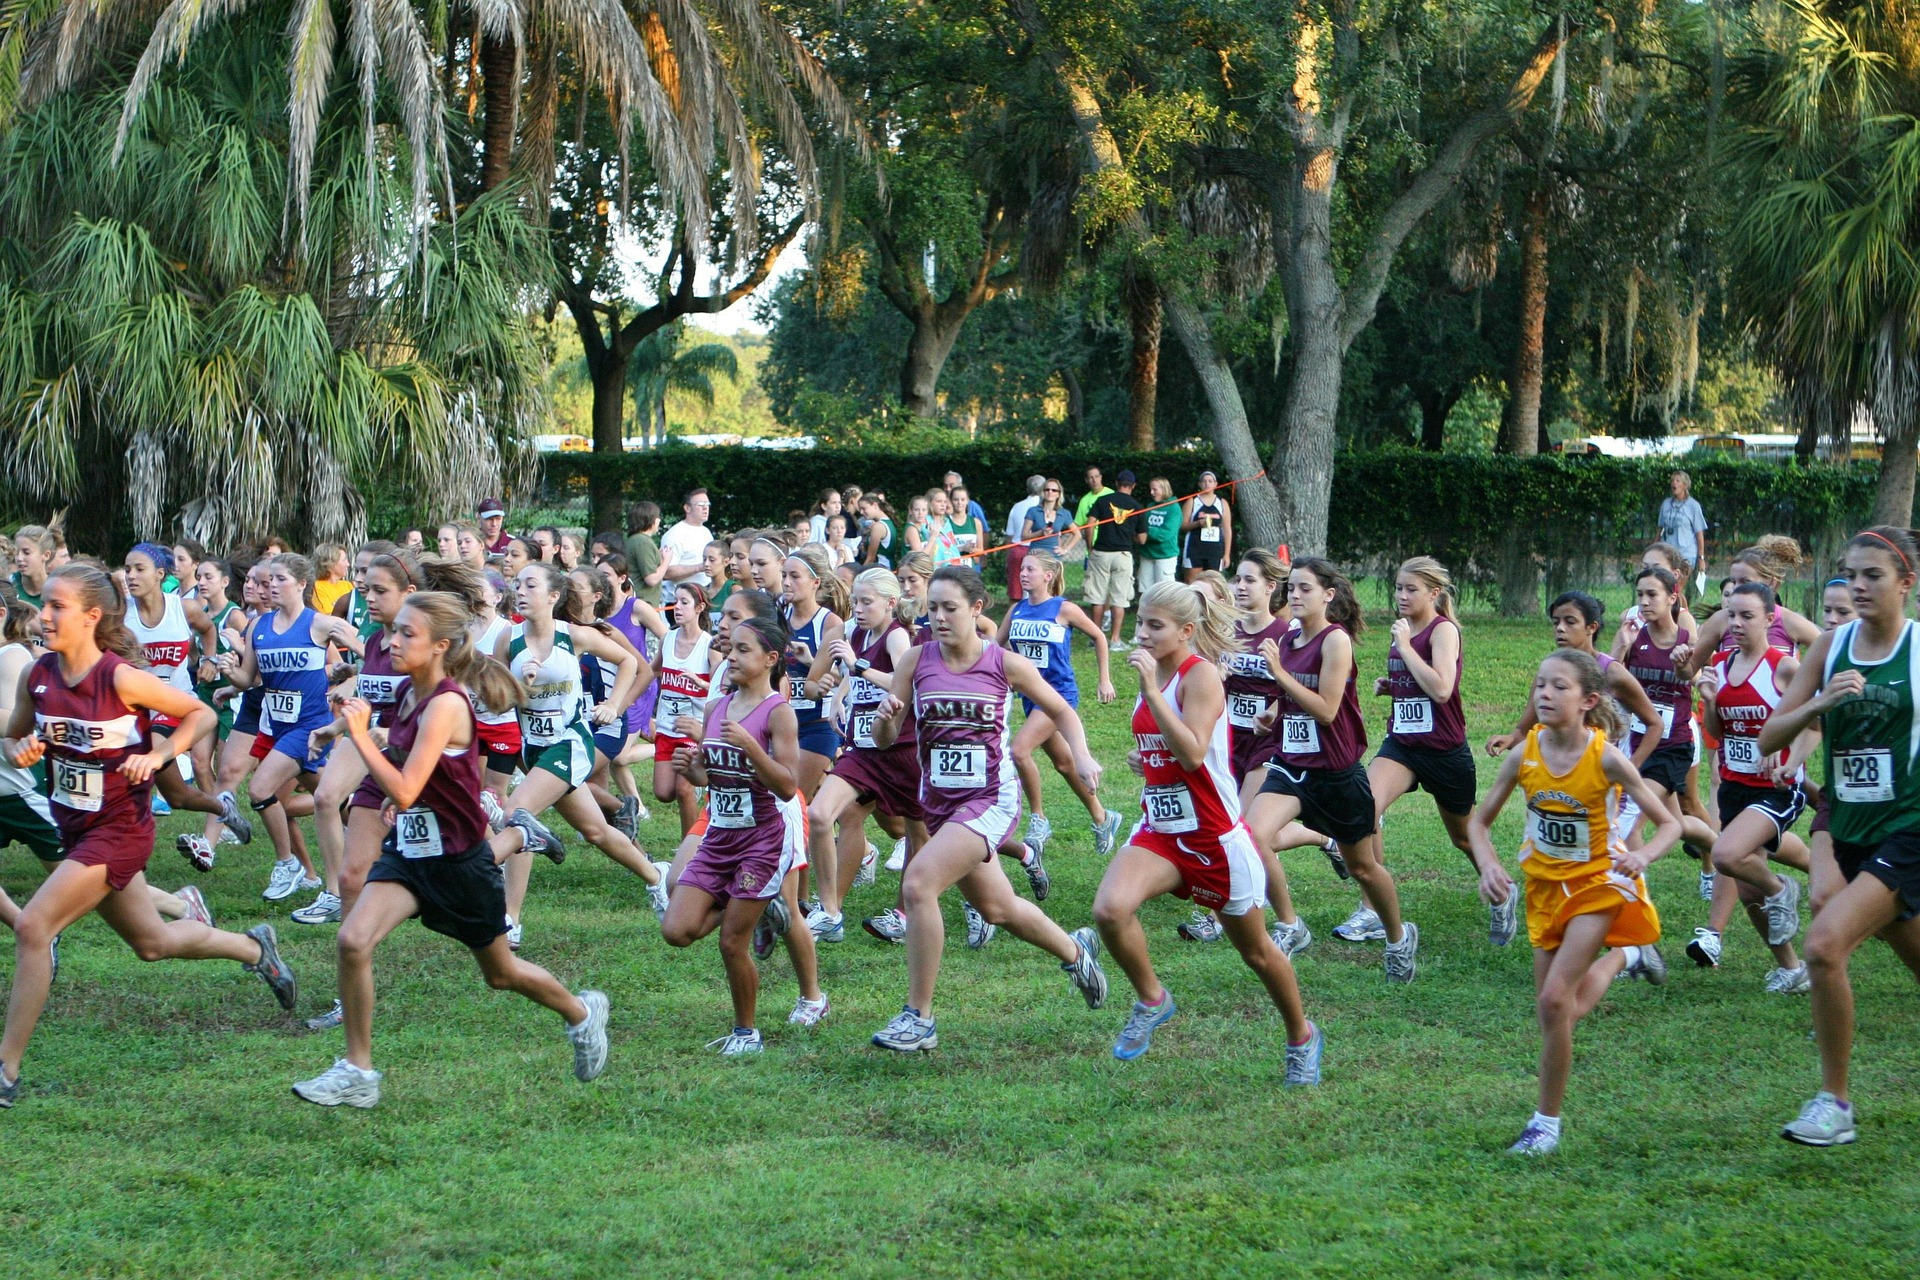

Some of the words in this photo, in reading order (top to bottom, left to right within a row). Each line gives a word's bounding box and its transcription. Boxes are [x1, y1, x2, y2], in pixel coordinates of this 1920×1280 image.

[271, 695, 294, 711] 176
[672, 701, 679, 713] 3
[1233, 698, 1257, 715] 255
[1399, 703, 1424, 719] 300
[528, 716, 554, 733] 234
[859, 716, 877, 734] 25
[1287, 721, 1309, 739] 303
[1728, 741, 1752, 760] 356
[939, 751, 972, 772] 321
[1842, 756, 1880, 782] 428
[58, 765, 88, 792] 251
[715, 793, 744, 813] 322
[1151, 795, 1183, 817] 355
[402, 814, 429, 839] 298
[1538, 819, 1577, 844] 409
